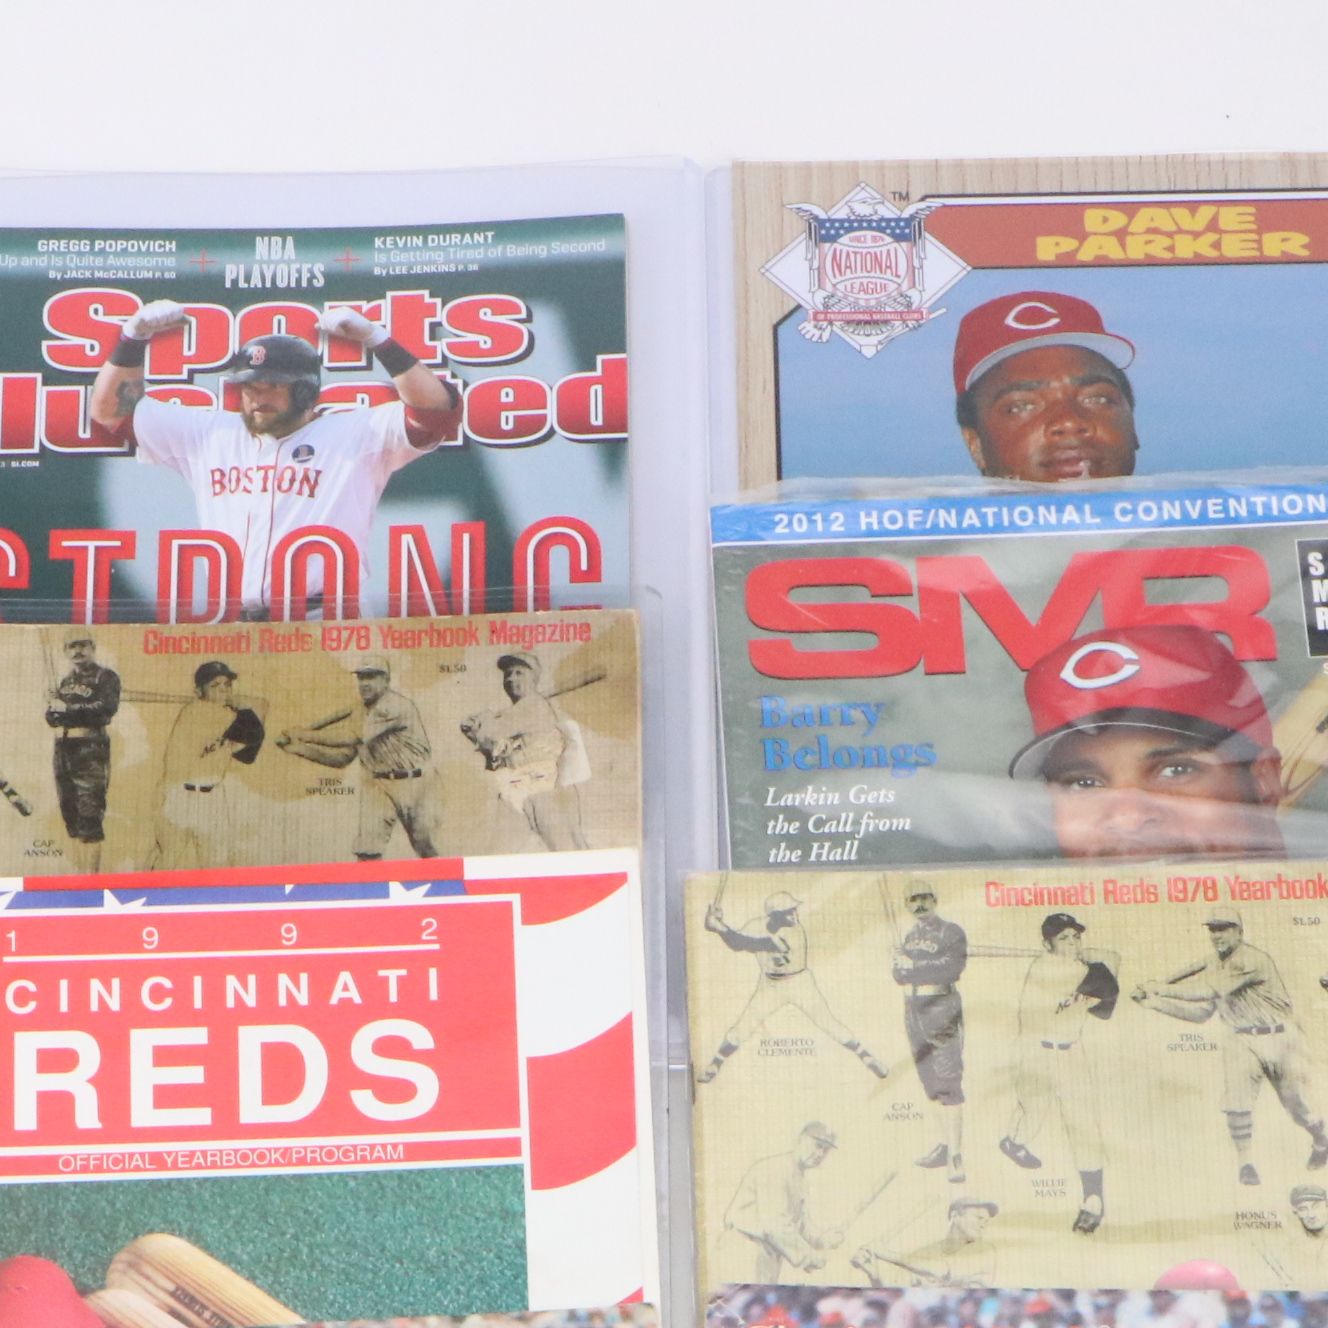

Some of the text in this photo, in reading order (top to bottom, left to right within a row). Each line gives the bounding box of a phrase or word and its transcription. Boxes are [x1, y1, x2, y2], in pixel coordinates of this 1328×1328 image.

[1083, 205, 1258, 233] DAVE
[37, 239, 177, 253] GREGG POPOVICH
[255, 236, 296, 261] NBA
[374, 231, 496, 249] KEVIN DURANT
[550, 239, 607, 254] Second
[1035, 230, 1312, 262] PARKER
[20, 254, 49, 267] and
[66, 253, 105, 268] Quite
[106, 254, 177, 267] Awesome
[224, 262, 326, 290] PLAYOFFS
[831, 246, 902, 279] NATIONAL
[844, 280, 891, 295] LEAGUE
[42, 286, 532, 379] Sports
[209, 464, 324, 499] BOSTON
[773, 511, 846, 534] 2012
[859, 504, 1102, 531] HOF/NATIONAL
[1113, 493, 1327, 523] CONVENTION
[744, 544, 1280, 680] SMR
[143, 618, 593, 657] Cincinnati 1978 Yearbook Magazine
[759, 693, 888, 737] Barry
[761, 733, 939, 779] Belongs
[764, 783, 897, 807] Larkin Gets
[766, 810, 913, 839] the Call from
[768, 839, 860, 864] the Hall
[984, 879, 1096, 908] Cincinnati
[1103, 877, 1160, 906] Reds
[1166, 875, 1220, 904] 1978
[4, 967, 441, 1015] CINCINNATI
[759, 1038, 815, 1048] ROBERTO
[13, 1018, 441, 1133] REDS
[58, 1142, 406, 1173] OFFICIAL YEARBOOK/PROGRAM
